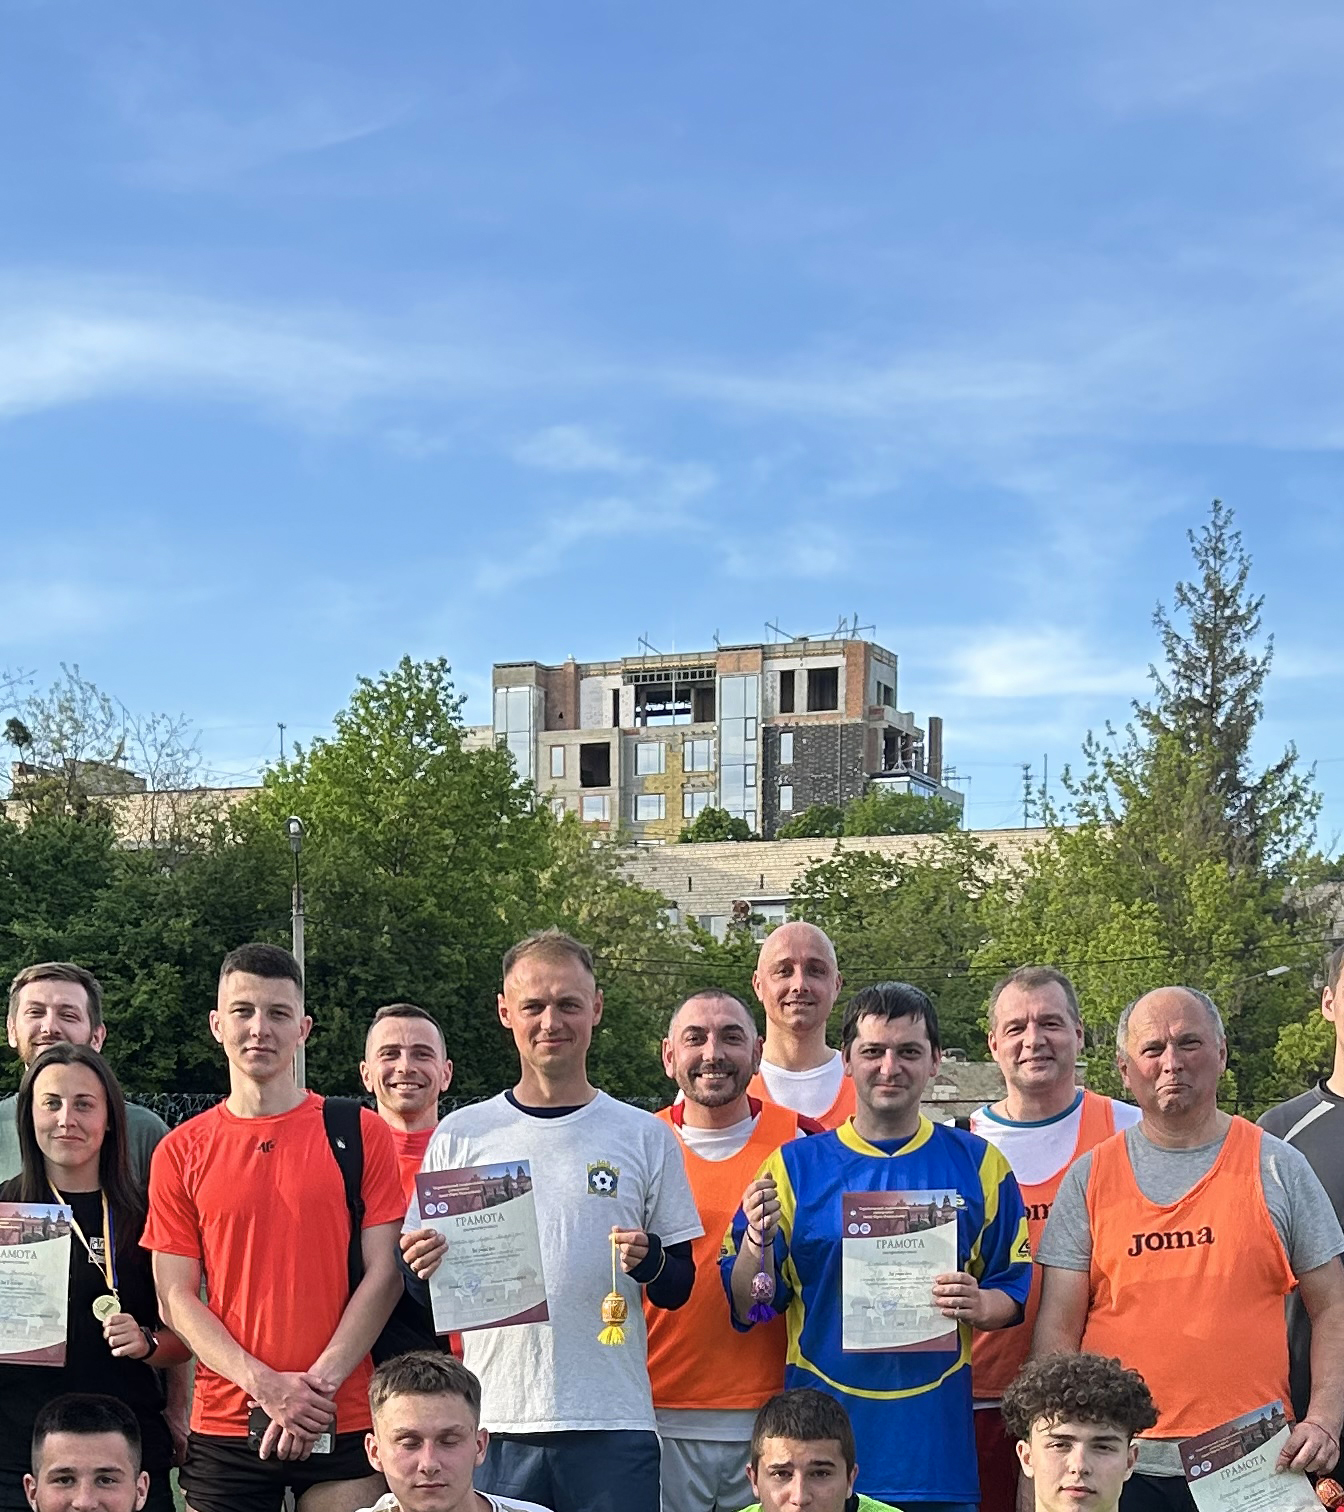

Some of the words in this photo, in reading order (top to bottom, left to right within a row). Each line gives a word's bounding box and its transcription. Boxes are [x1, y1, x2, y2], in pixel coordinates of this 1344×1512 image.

[456, 1212, 505, 1227] ГРАМОТА
[876, 1239, 925, 1249] ГРАМОТА
[1220, 1454, 1267, 1480] ГРАМОТА
